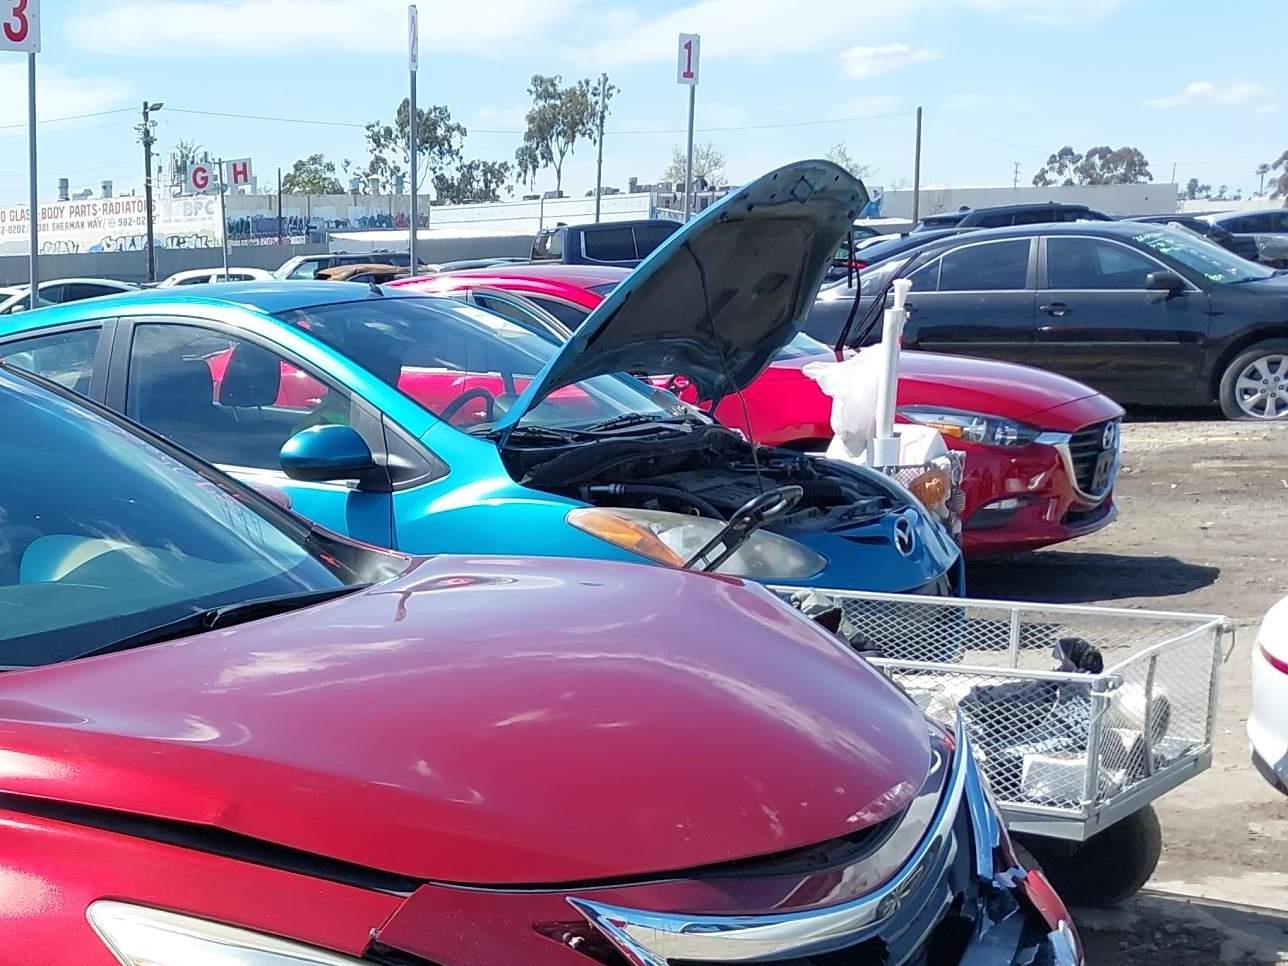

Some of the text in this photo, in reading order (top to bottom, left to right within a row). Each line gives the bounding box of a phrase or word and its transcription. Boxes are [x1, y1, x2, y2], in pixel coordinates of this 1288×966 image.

[3, 0, 28, 42] 3
[682, 39, 694, 78] 1
[192, 166, 209, 189] G
[232, 162, 248, 184] H
[52, 219, 85, 231] SHERMAN
